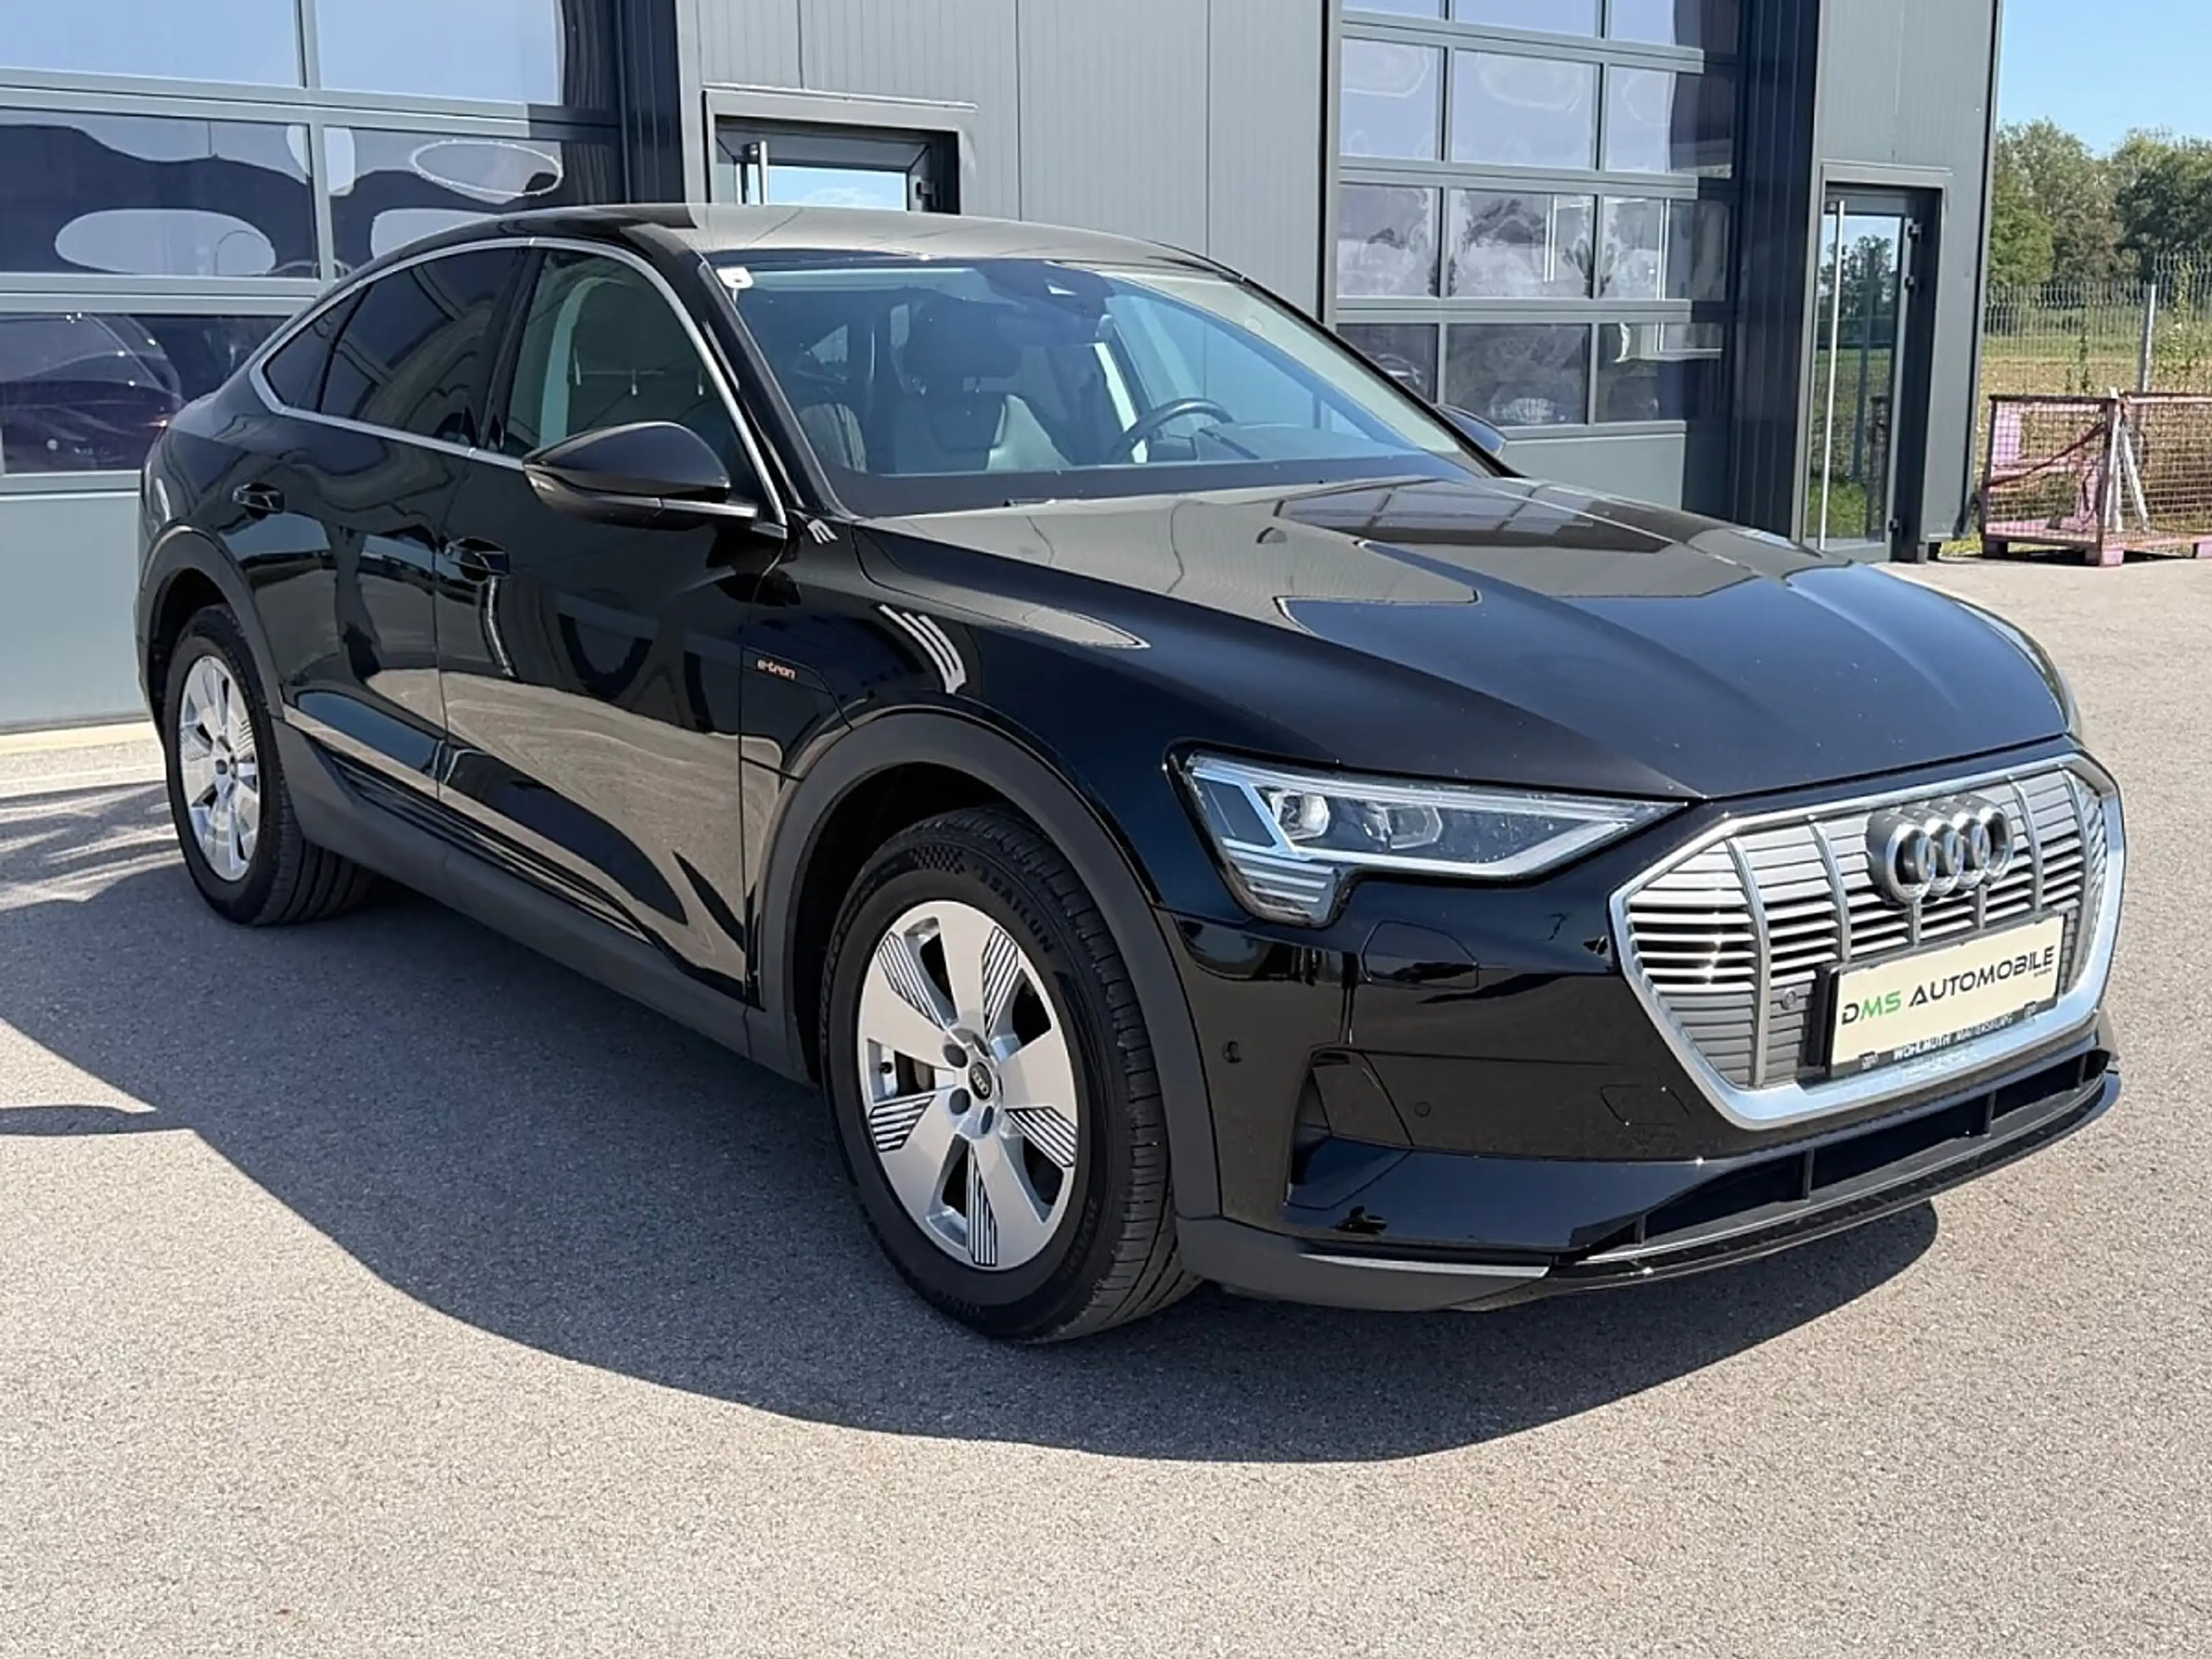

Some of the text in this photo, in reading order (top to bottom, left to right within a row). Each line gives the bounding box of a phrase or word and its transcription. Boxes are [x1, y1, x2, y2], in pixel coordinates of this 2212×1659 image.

[757, 659, 796, 680] e-tron
[1842, 946, 2054, 1025] DMS AUTOMOBILE
